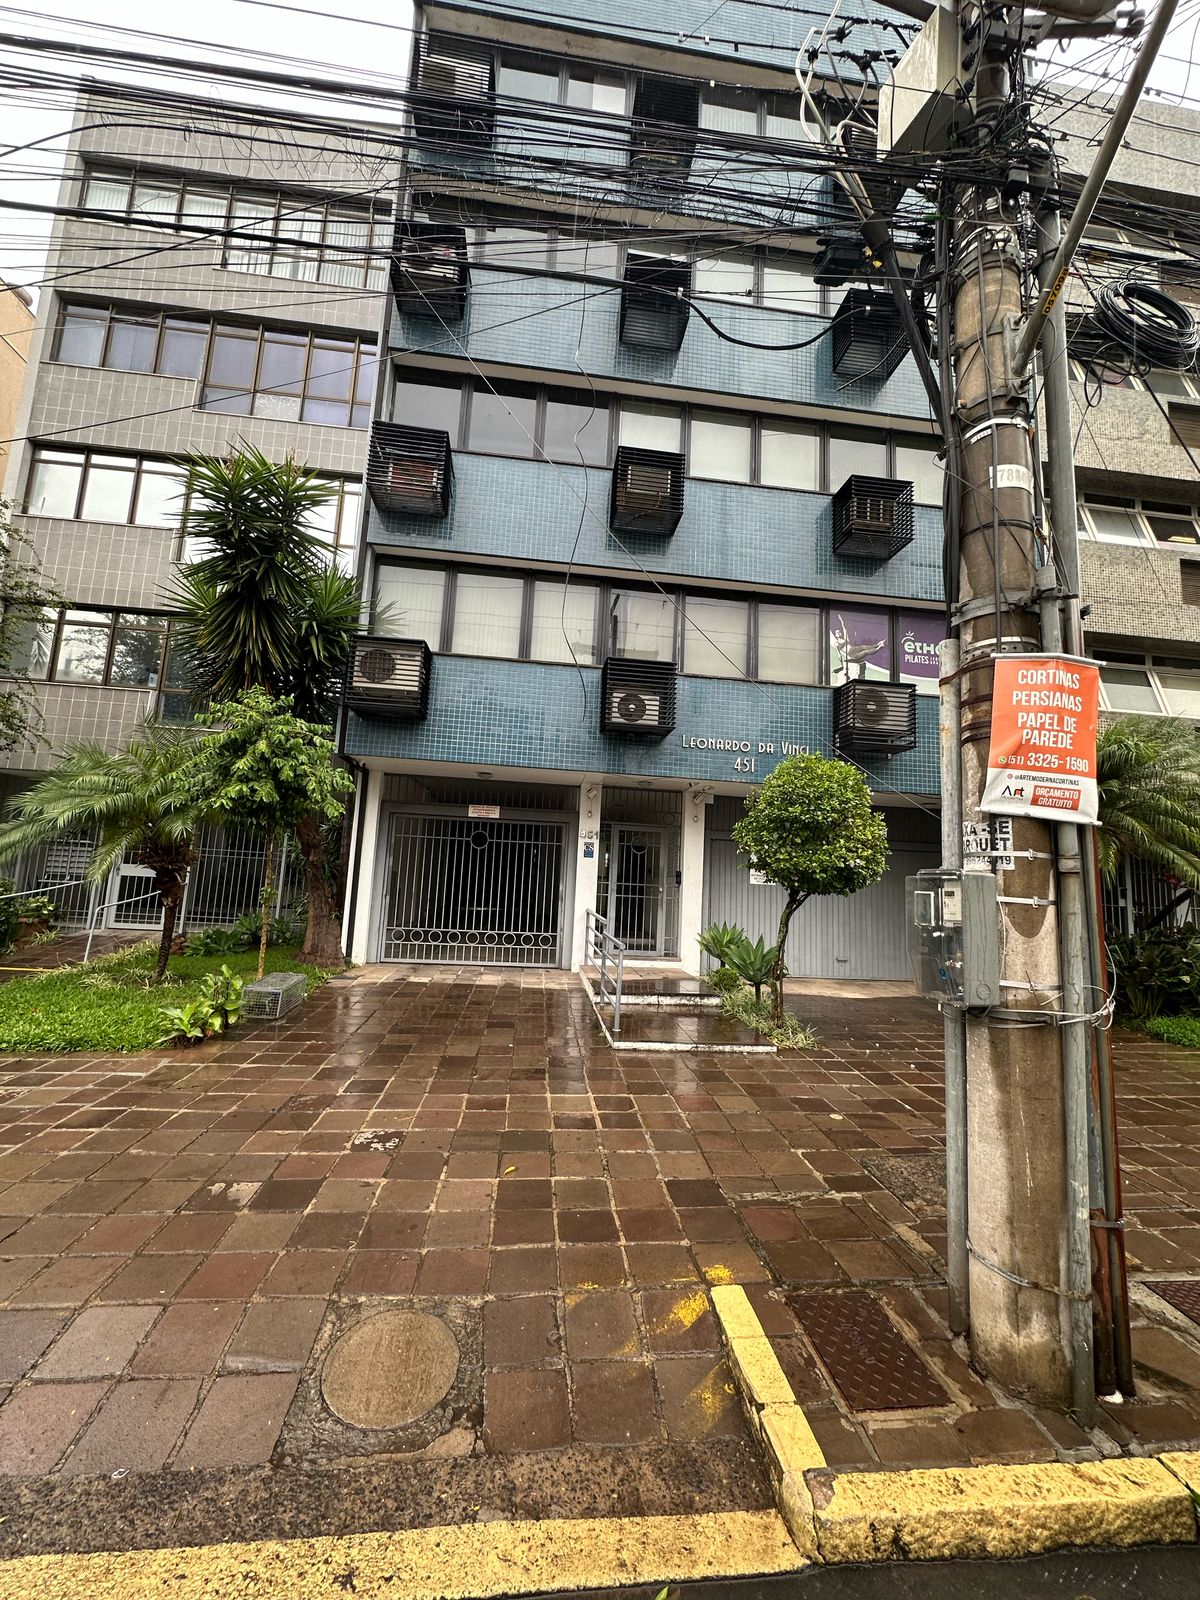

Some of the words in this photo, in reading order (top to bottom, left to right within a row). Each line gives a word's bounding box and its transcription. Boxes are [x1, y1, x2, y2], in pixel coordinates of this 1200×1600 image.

[904, 654, 929, 665] PILATES
[1017, 669, 1080, 689] CORTINAS
[1012, 690, 1083, 712] PERSIANAS
[1017, 711, 1061, 730] PAPEL
[1063, 714, 1077, 733] DE
[1021, 728, 1074, 749] PAREDE
[758, 742, 774, 754] DA
[733, 756, 755, 773] 451
[1007, 755, 1025, 765] (51)
[1014, 774, 1080, 786] @ARTEMODERNACORTINAS
[1035, 787, 1079, 799] ORÇAMENTO
[1037, 797, 1073, 809] GRATUITO
